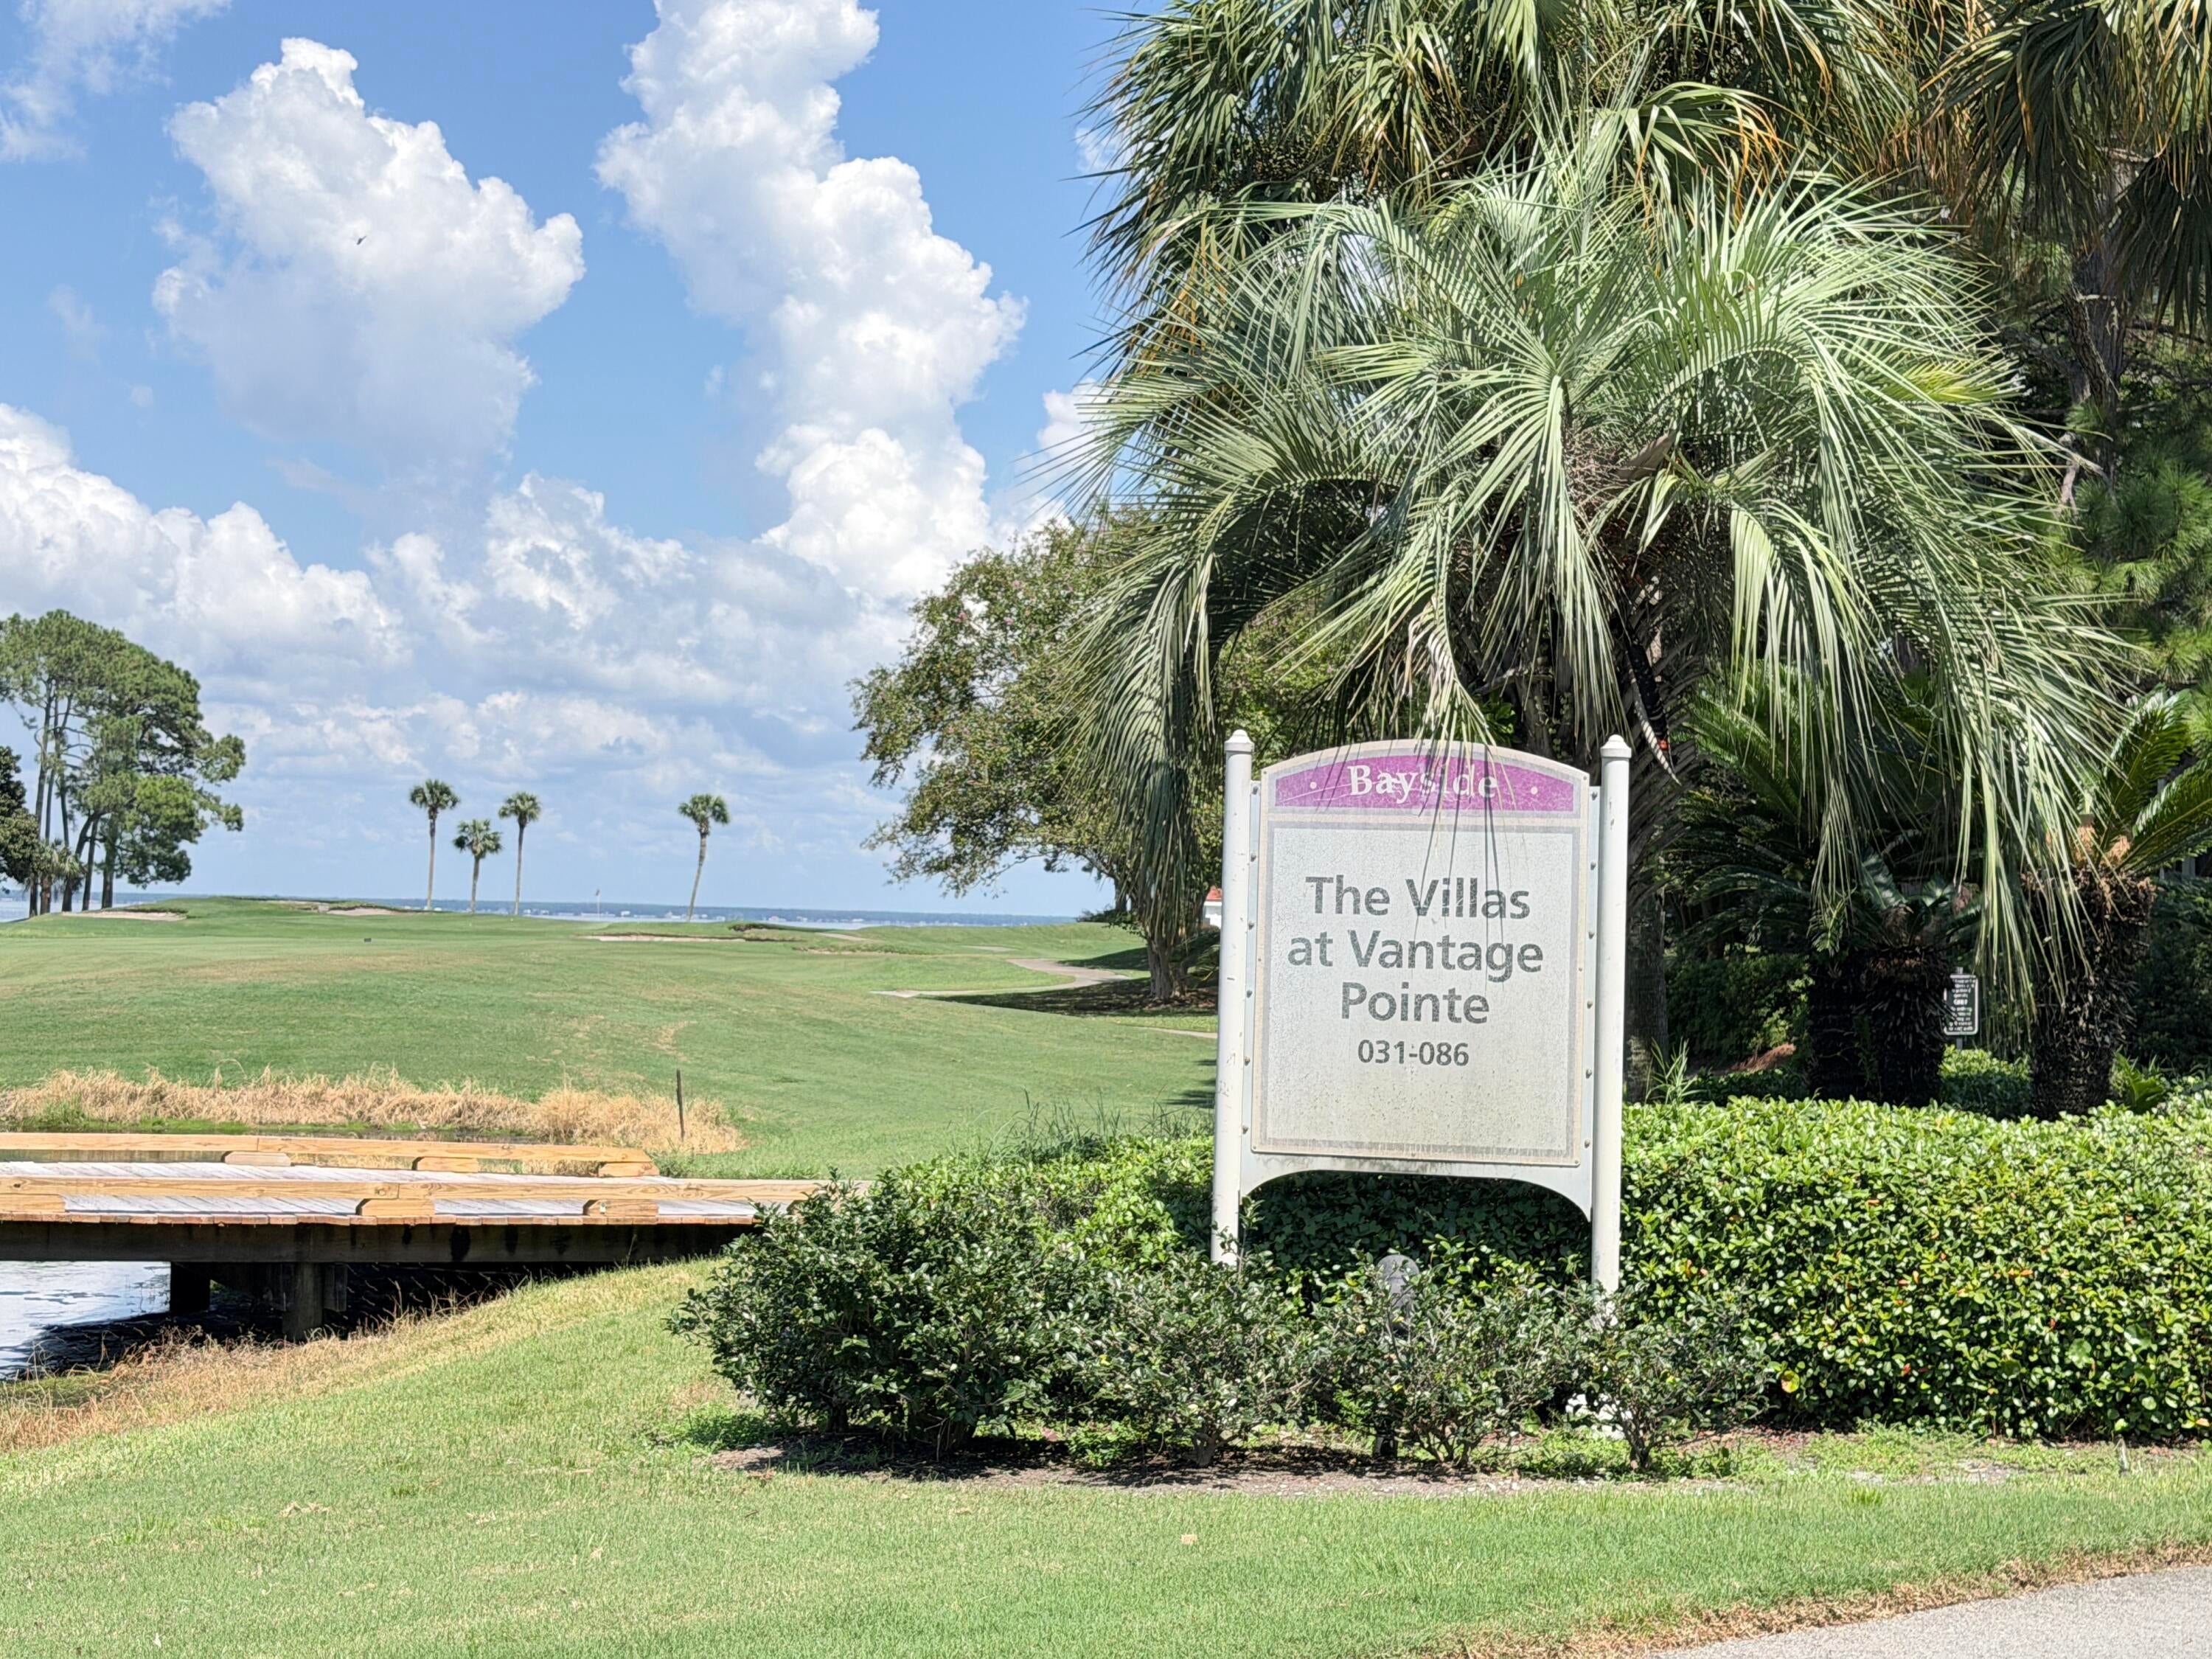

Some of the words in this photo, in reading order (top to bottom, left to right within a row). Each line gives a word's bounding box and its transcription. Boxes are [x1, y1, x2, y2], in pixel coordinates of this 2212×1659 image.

[1306, 875, 1391, 916] The
[1405, 878, 1531, 919] Villas
[1287, 931, 1333, 967] at
[1348, 930, 1543, 982] Vantage
[1341, 981, 1489, 1023] Pointe
[1357, 1040, 1470, 1066] 031-086
